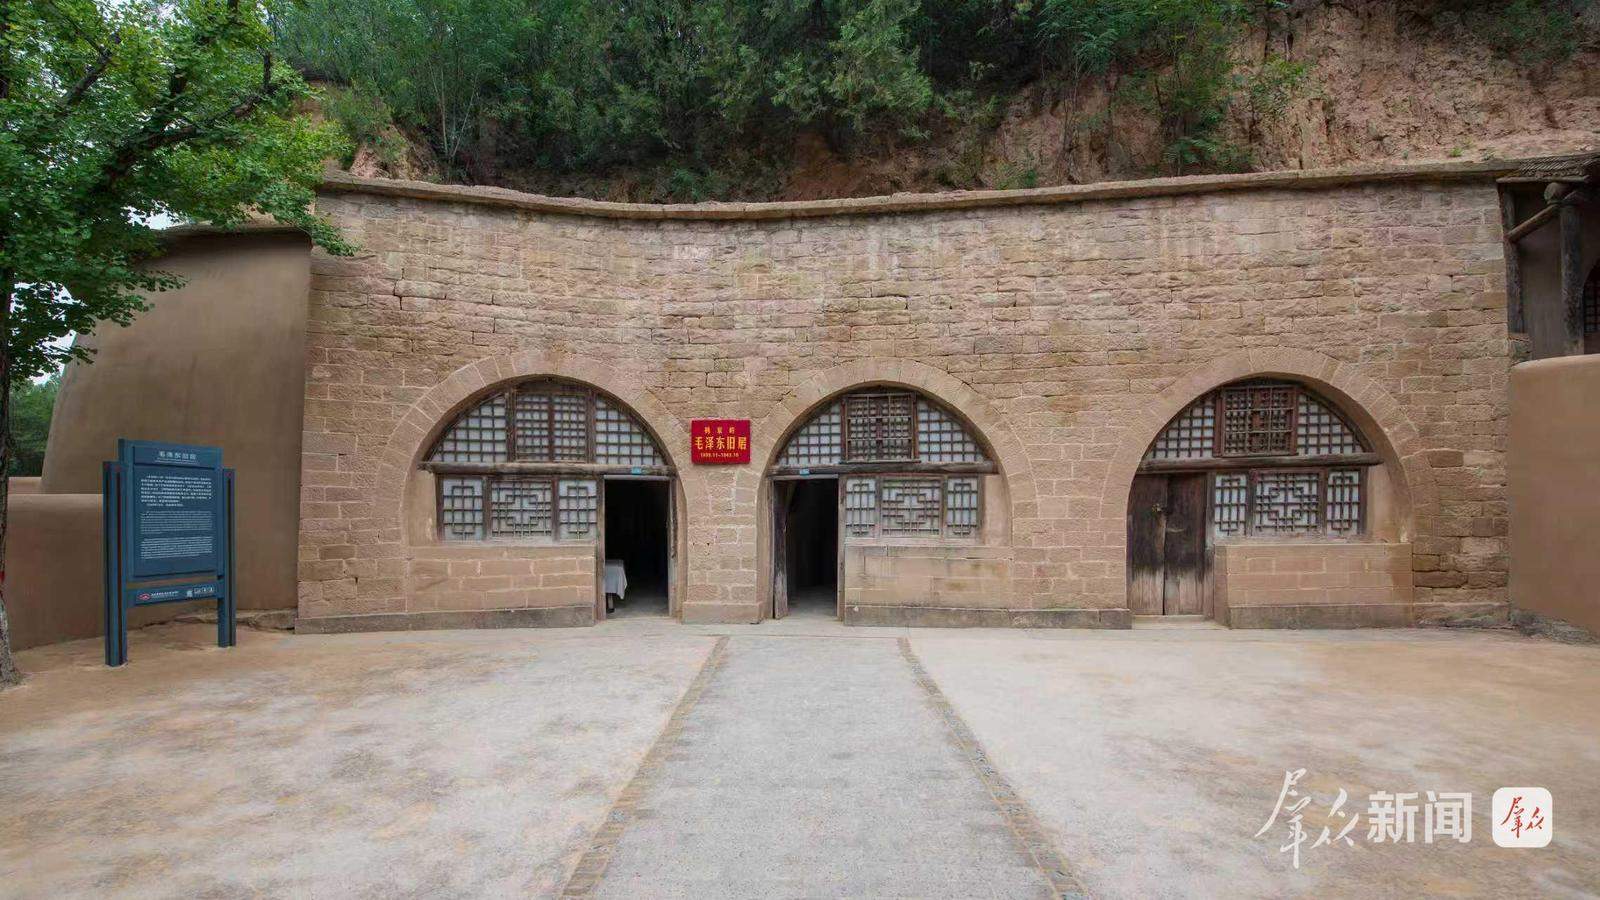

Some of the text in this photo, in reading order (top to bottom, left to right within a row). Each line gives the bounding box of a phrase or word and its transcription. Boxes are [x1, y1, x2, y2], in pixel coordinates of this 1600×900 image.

[695, 436, 746, 450] 毛泽东旧居
